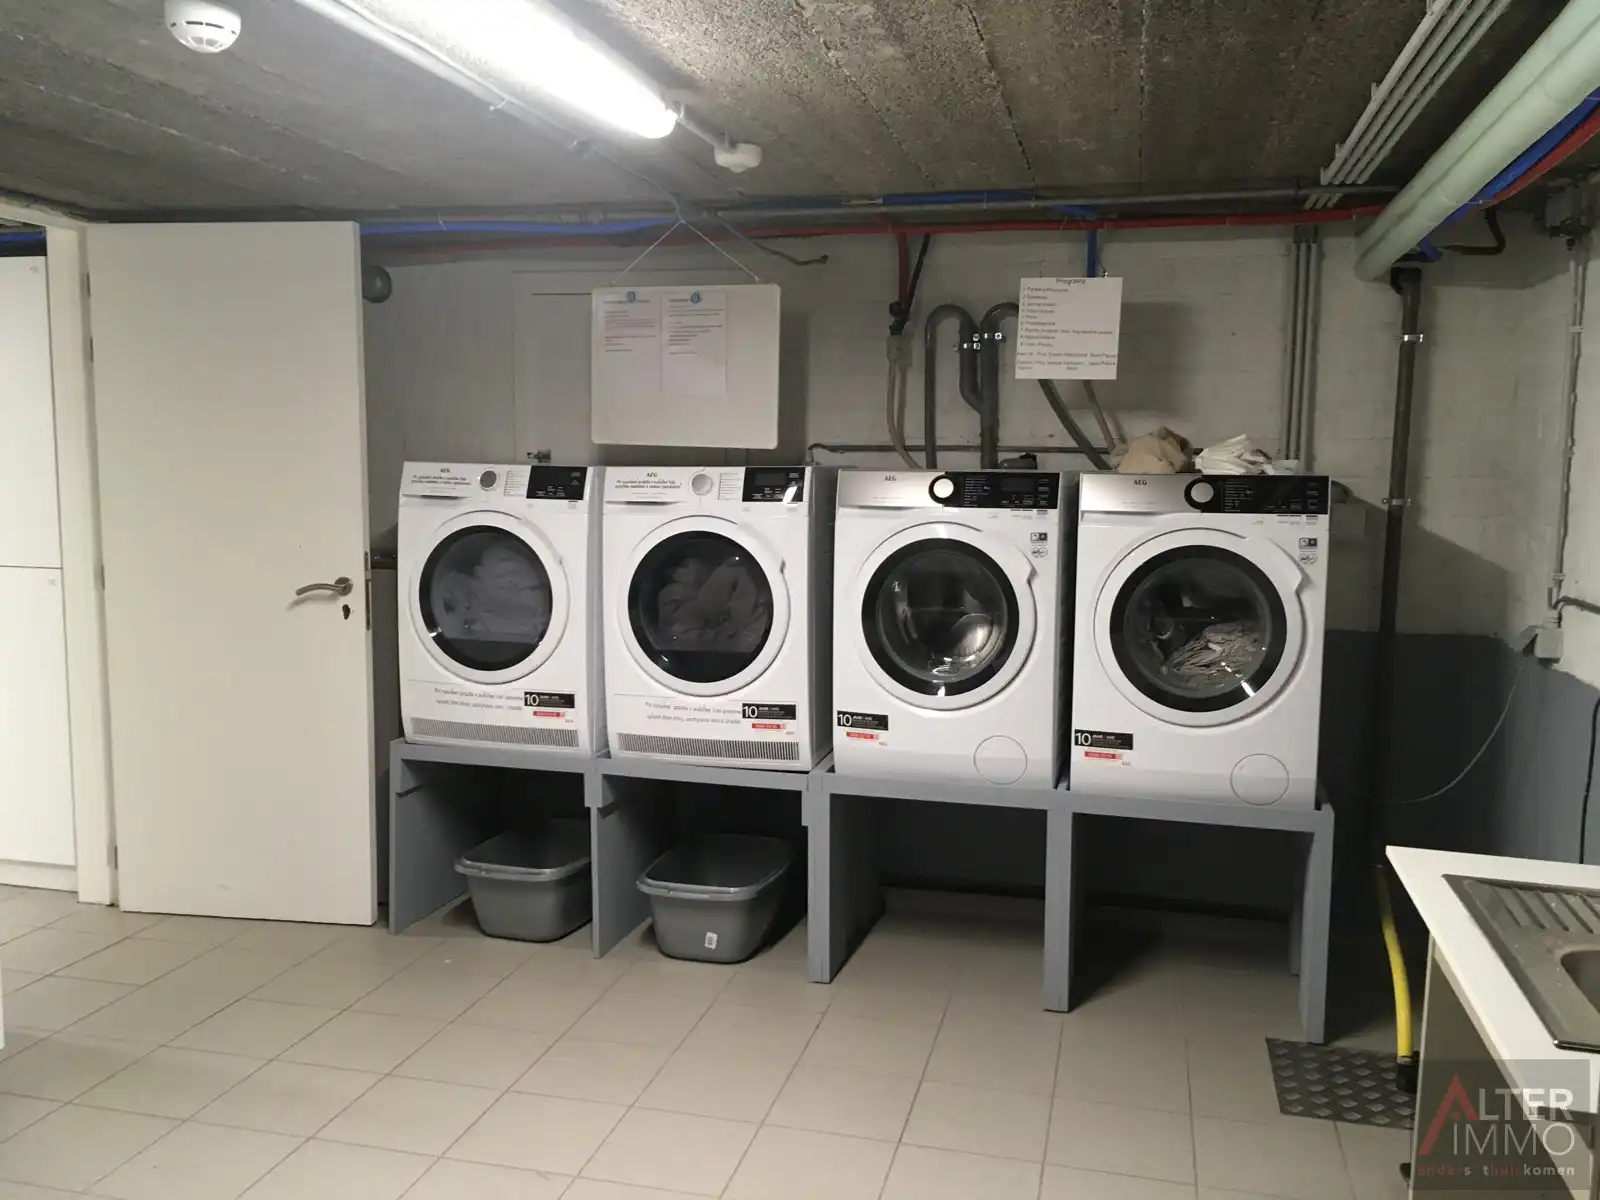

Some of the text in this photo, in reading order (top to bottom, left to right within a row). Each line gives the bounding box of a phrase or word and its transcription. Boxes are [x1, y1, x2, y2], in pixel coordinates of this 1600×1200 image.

[525, 694, 539, 706] 10
[743, 706, 758, 718] 10
[837, 713, 852, 726] 10
[1075, 732, 1091, 746] 10
